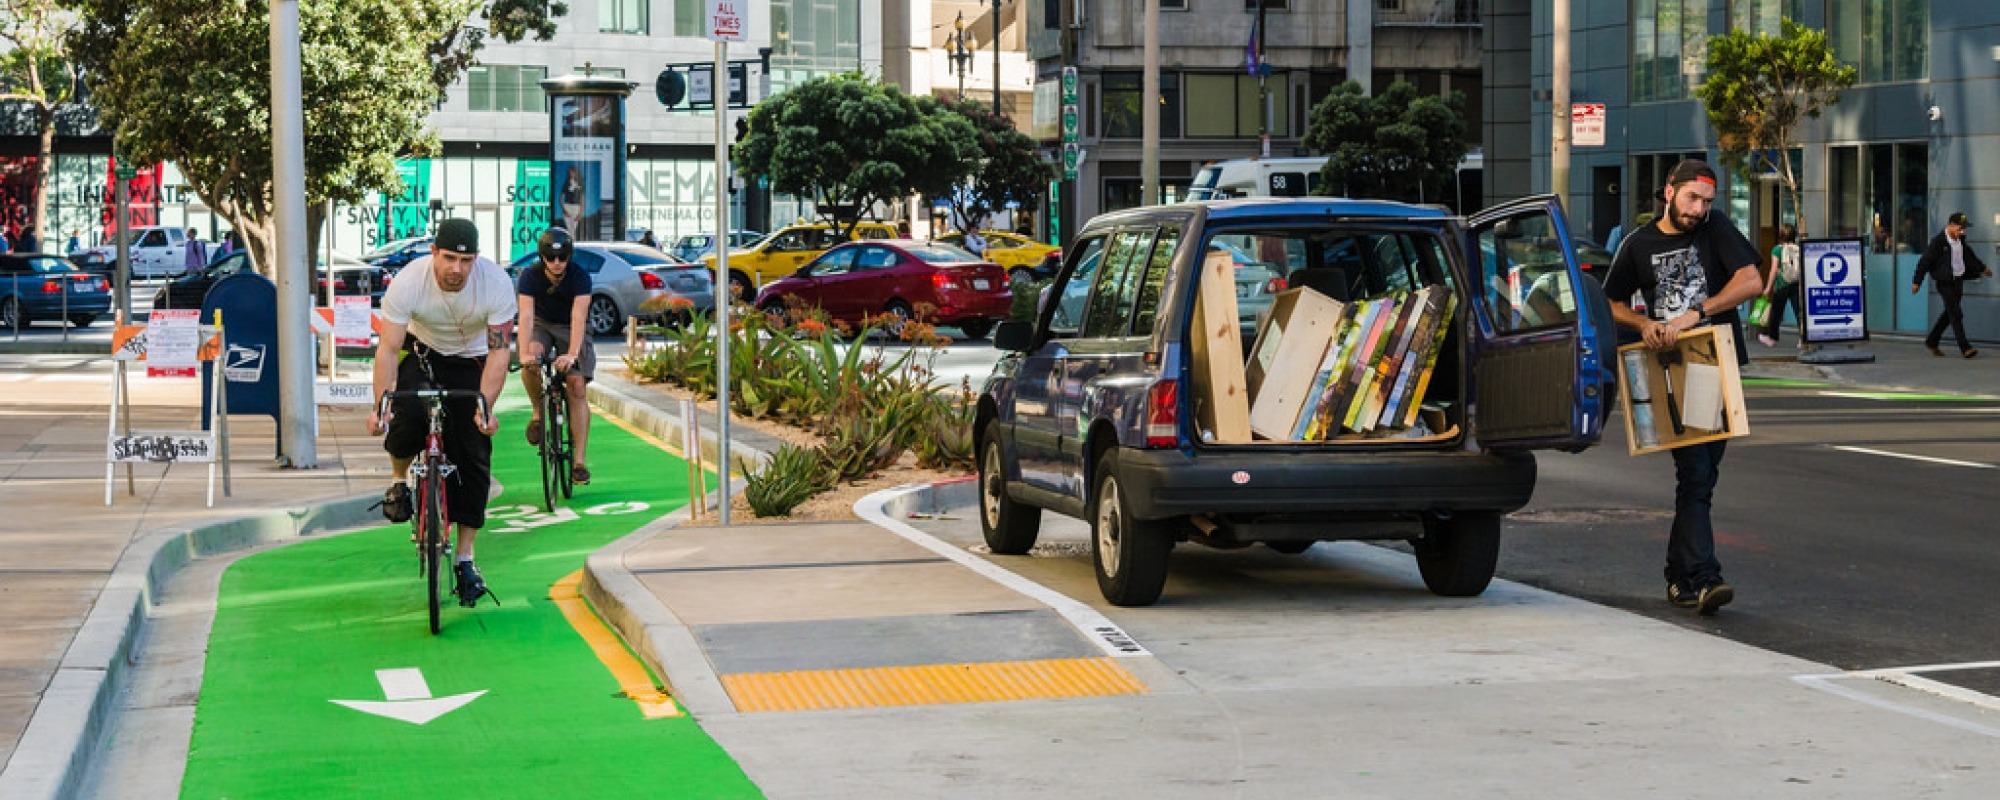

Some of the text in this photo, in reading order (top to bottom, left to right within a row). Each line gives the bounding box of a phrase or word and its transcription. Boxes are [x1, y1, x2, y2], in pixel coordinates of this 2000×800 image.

[717, 2, 735, 15] ALL
[713, 16, 741, 29] TIMES
[1273, 176, 1286, 188] 58
[1829, 243, 1860, 252] Parking
